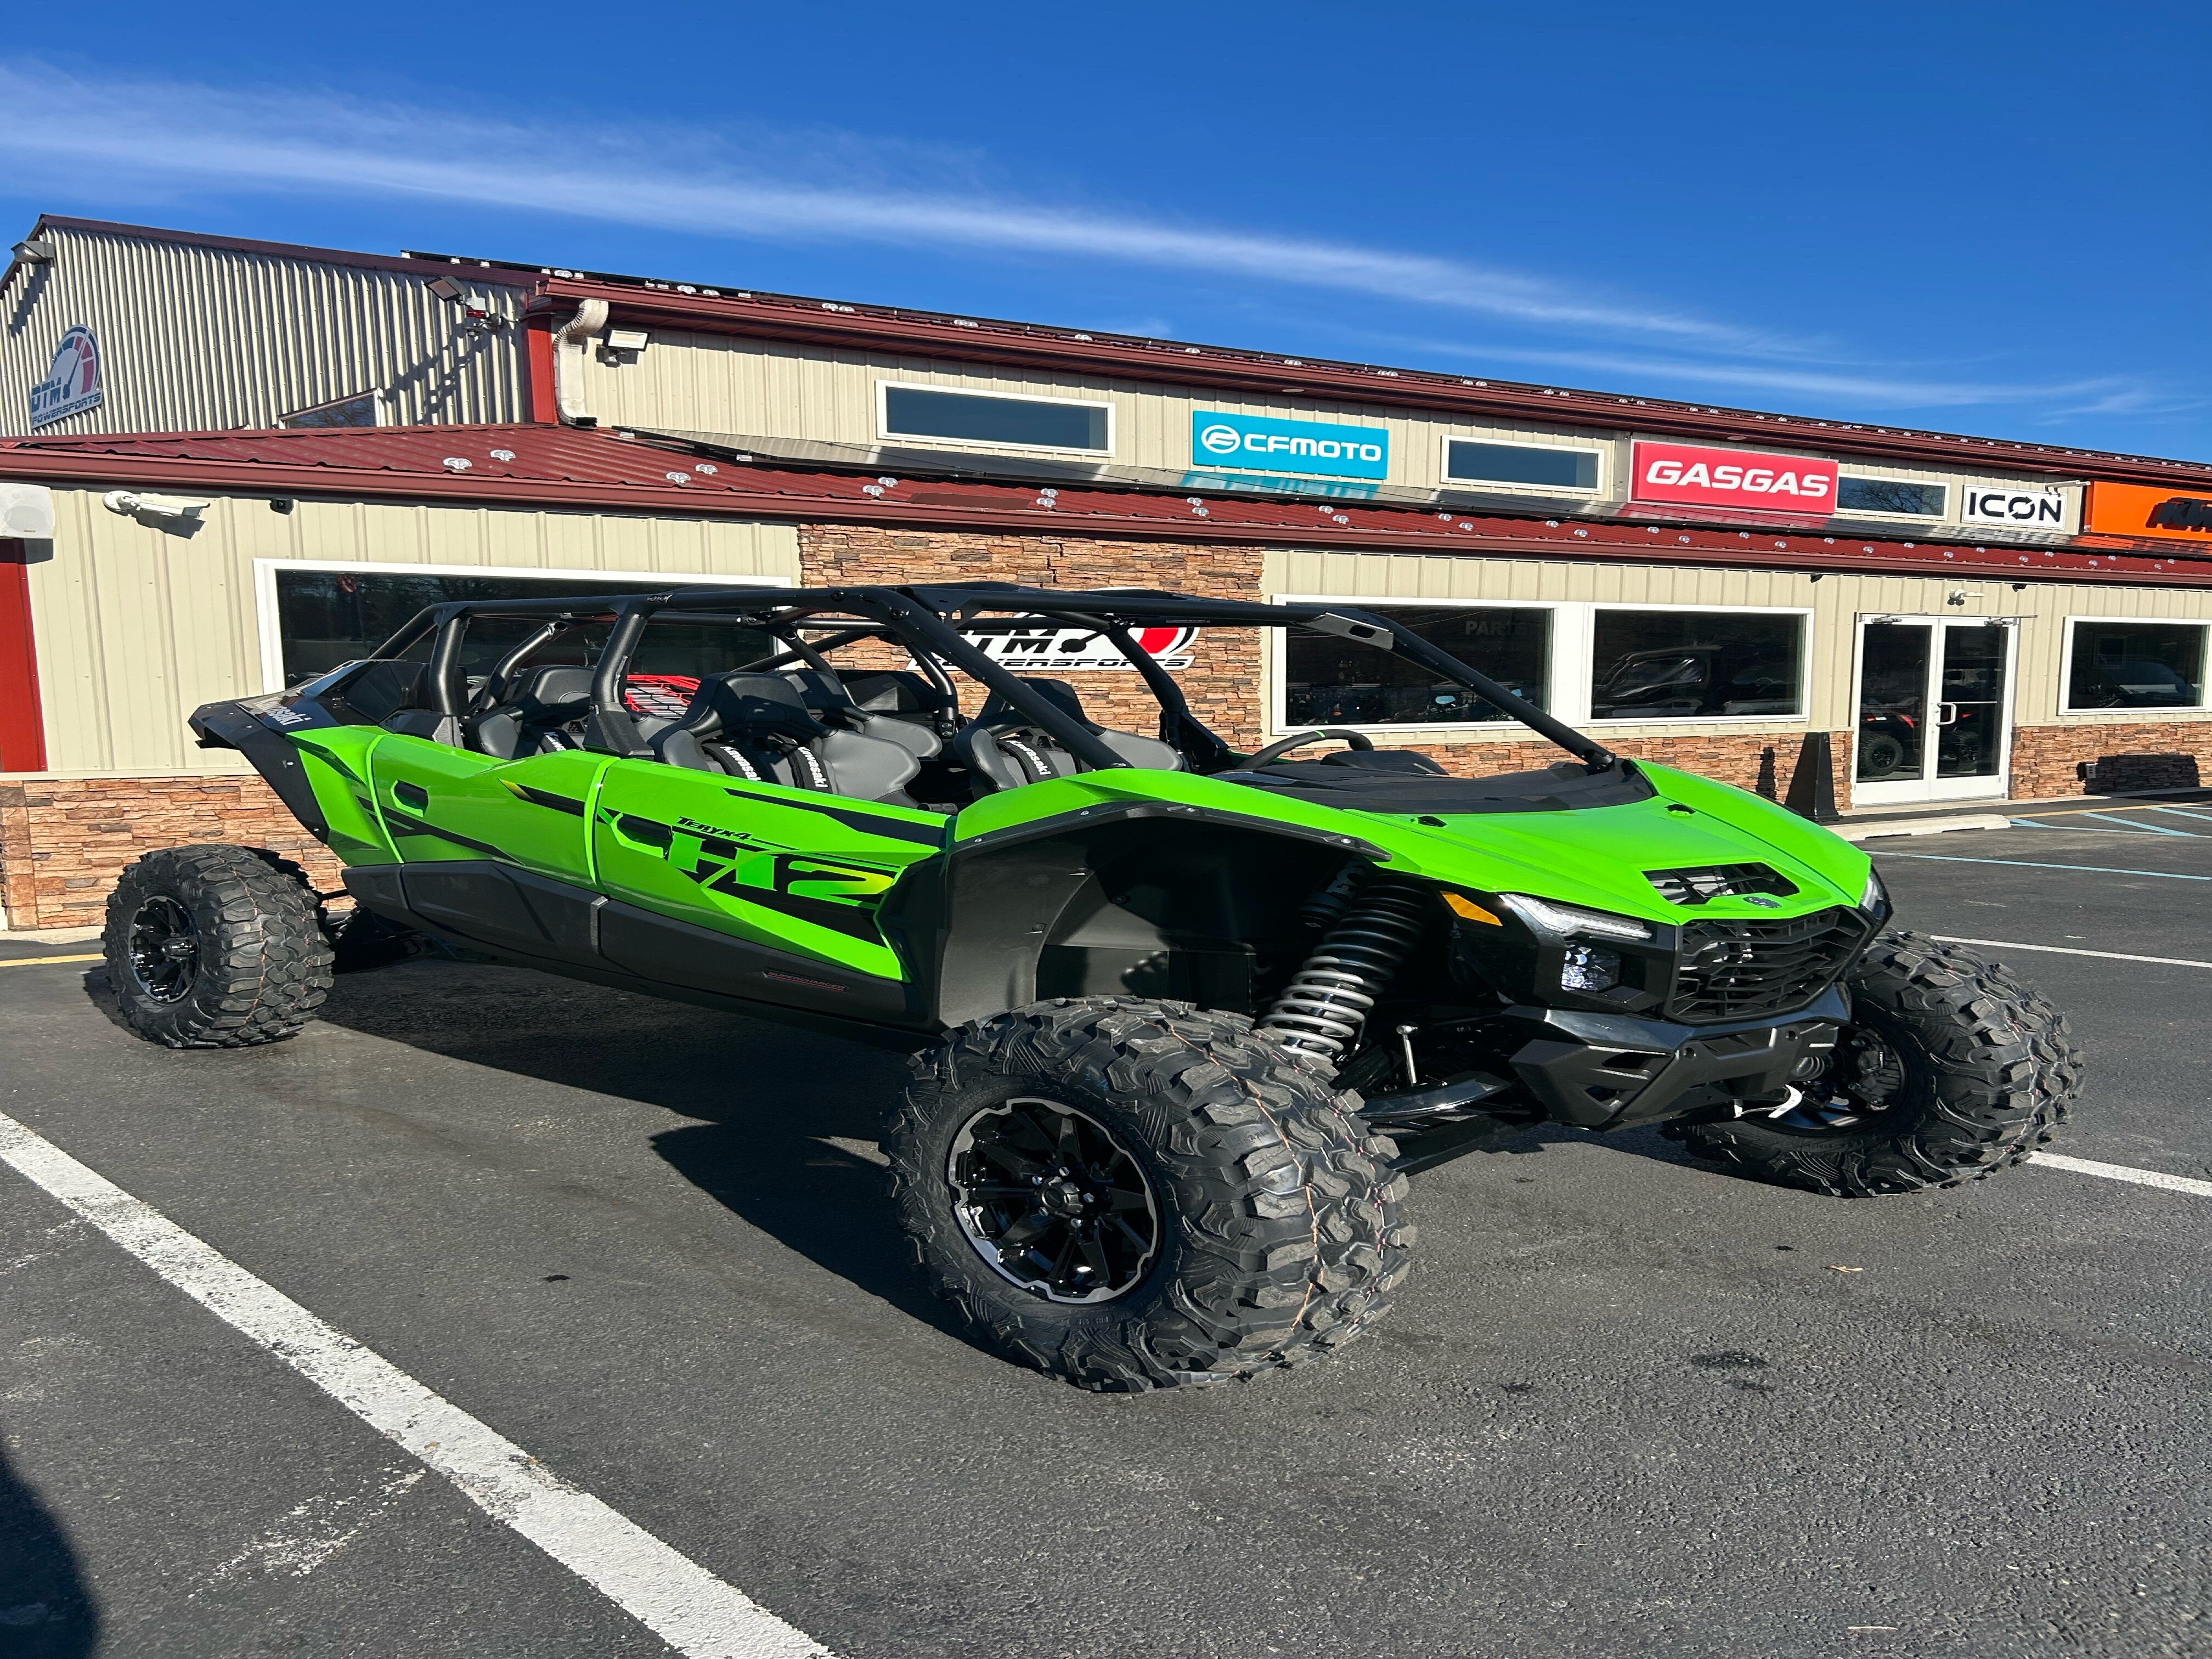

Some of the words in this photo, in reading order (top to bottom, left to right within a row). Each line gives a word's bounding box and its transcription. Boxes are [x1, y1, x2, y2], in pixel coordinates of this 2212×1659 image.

[32, 392, 101, 426] POWERSPORTS
[1244, 433, 1381, 461] CFMOTO
[1646, 460, 1831, 498] GASGAS
[1969, 492, 2062, 523] ICON
[253, 696, 312, 726] Kawasaki
[668, 831, 894, 910] H2
